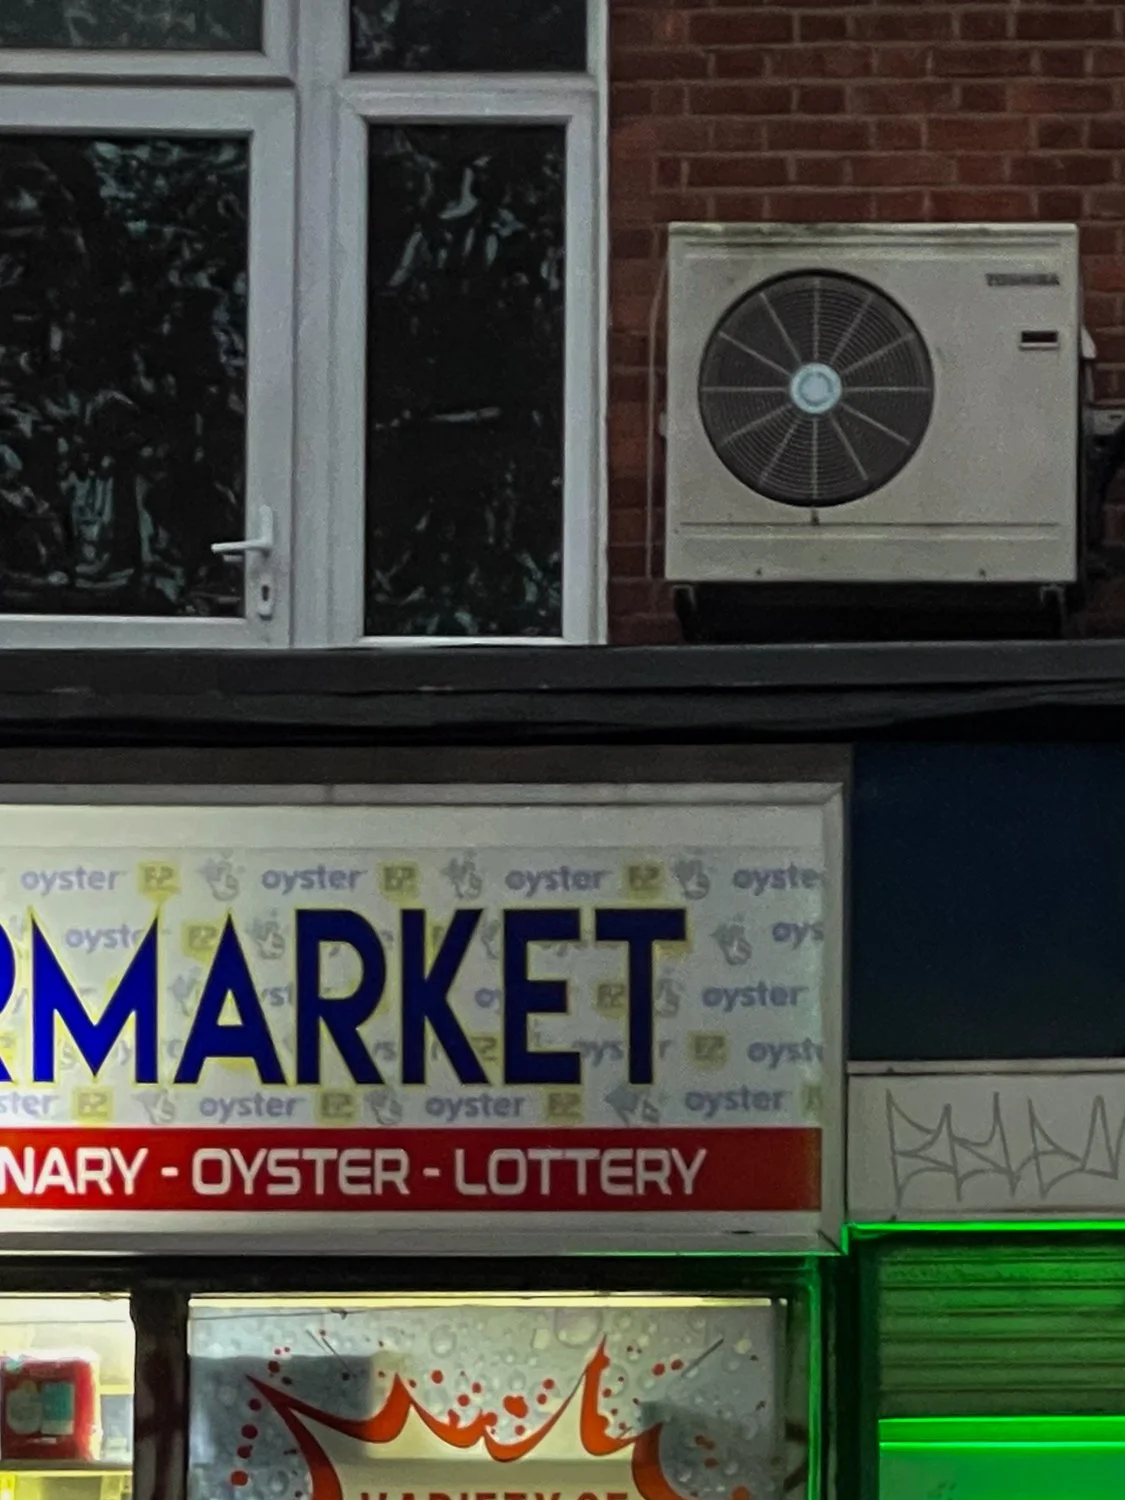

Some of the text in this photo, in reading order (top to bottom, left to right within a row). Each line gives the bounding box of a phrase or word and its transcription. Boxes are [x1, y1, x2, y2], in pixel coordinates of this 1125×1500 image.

[20, 866, 118, 896] oyster
[262, 866, 360, 896] oyster
[505, 866, 603, 896] oyster
[732, 863, 823, 896] oyste
[0, 908, 686, 1084] MARKET
[702, 981, 804, 1013] oyster
[199, 1091, 297, 1124] oyster
[425, 1091, 523, 1123] oyster
[685, 1086, 785, 1119] oyster
[0, 1147, 148, 1195] NARY
[192, 1148, 410, 1195] OYSTER
[455, 1148, 707, 1195] LOTTERY
